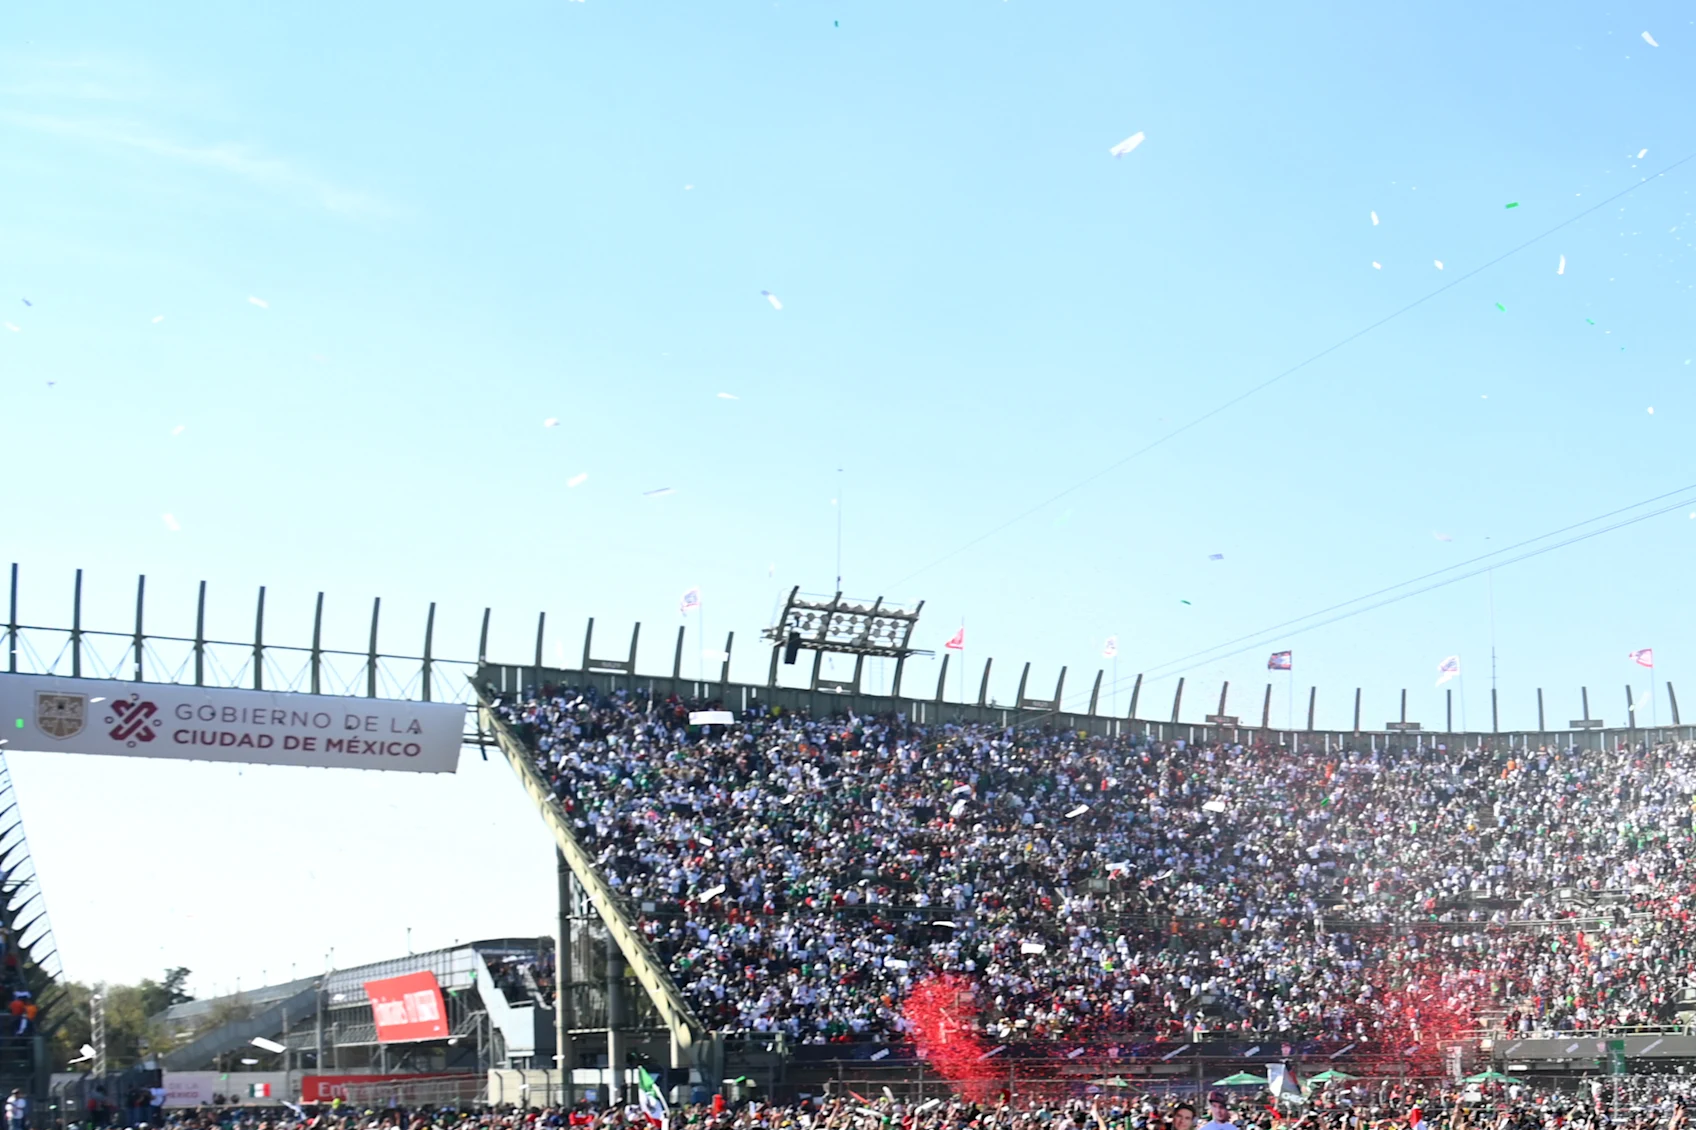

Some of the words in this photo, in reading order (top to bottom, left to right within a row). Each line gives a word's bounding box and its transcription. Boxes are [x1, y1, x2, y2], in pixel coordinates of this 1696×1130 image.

[175, 703, 332, 729] GOBIERNO
[344, 714, 378, 732] DE
[390, 717, 423, 735] LA
[173, 729, 274, 750] CIUDAD
[283, 735, 316, 752] DE
[325, 736, 421, 758] MÉXICO
